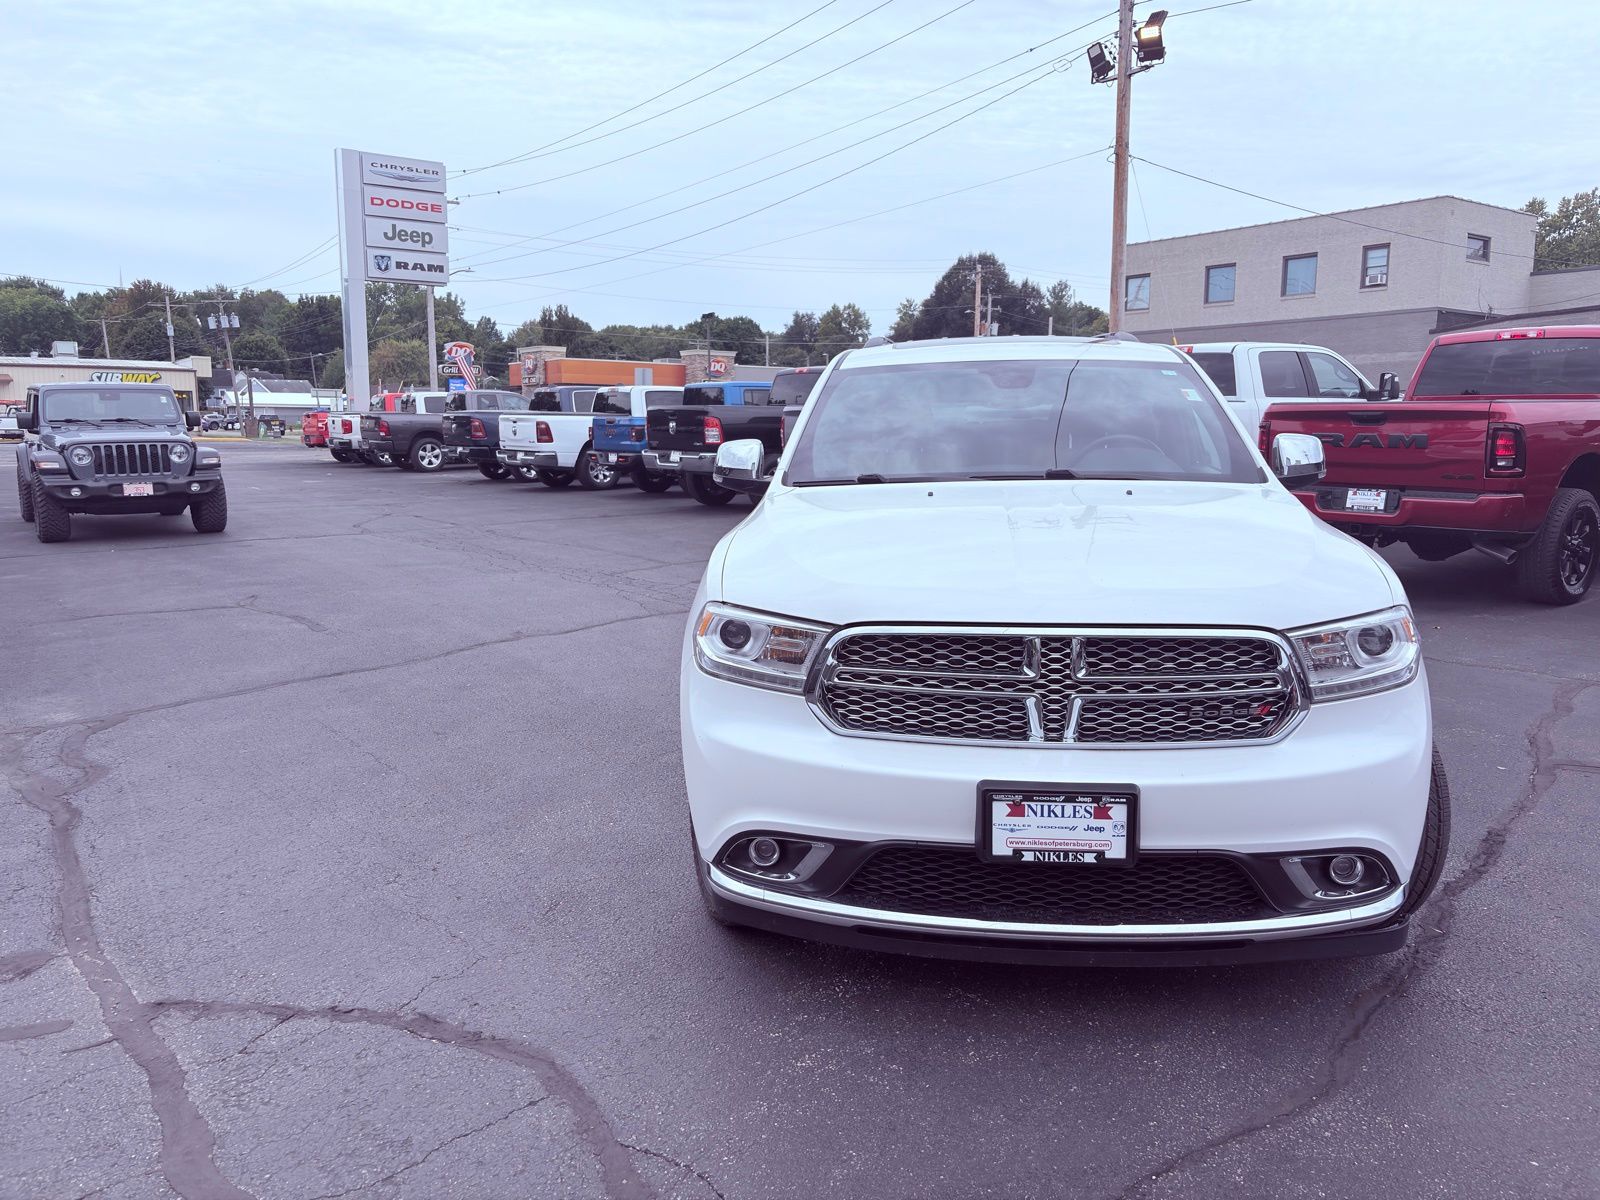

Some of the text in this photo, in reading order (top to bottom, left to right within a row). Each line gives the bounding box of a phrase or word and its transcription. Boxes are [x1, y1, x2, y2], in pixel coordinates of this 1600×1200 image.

[370, 162, 440, 176] CHRYSLER
[370, 196, 443, 214] DODGE
[383, 223, 434, 248] Jeep
[395, 260, 445, 274] RAM
[450, 346, 471, 358] DQ
[443, 366, 459, 375] Grill
[710, 361, 726, 373] DQ
[91, 372, 162, 384] SUBWAY
[1312, 433, 1428, 449] RAM
[1188, 707, 1262, 718] DODGE
[1026, 803, 1093, 819] NIKLES
[1083, 824, 1106, 833] Jeep
[1008, 839, 1110, 848] www.niklesofpetersburg.com
[1034, 851, 1084, 863] NIKLES
